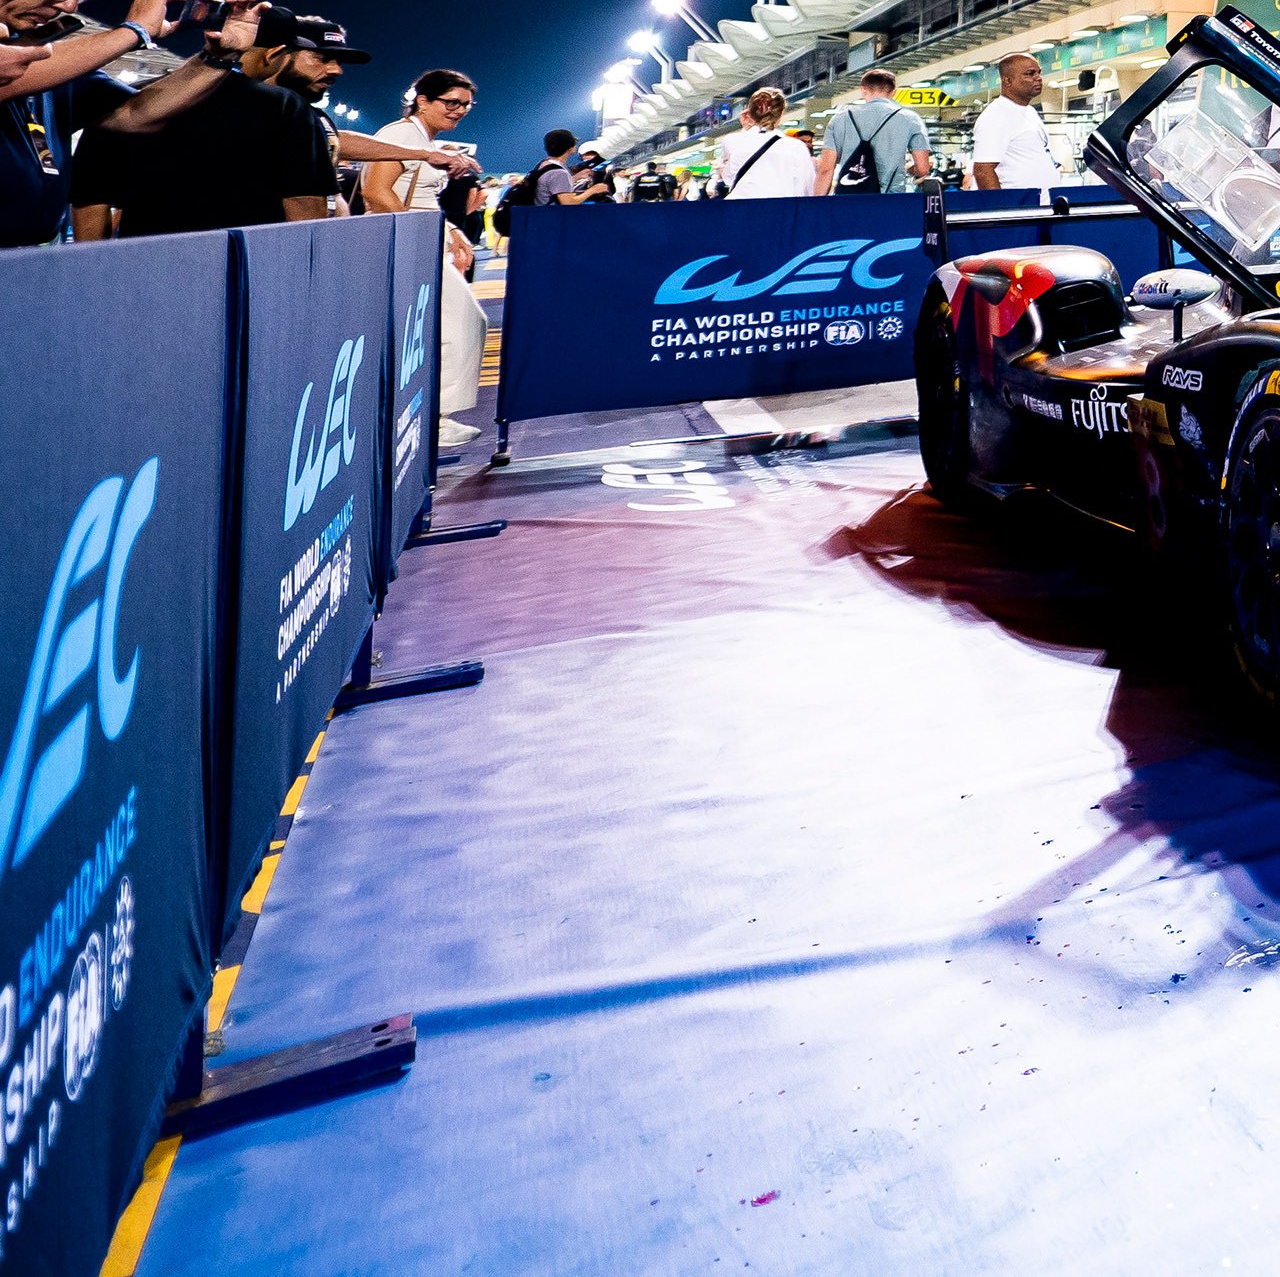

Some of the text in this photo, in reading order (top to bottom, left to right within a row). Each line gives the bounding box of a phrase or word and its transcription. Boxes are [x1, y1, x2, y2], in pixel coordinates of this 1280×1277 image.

[909, 90, 936, 106] 93
[924, 195, 940, 214] JFE
[653, 237, 924, 305] WEC
[1138, 282, 1158, 295] Mobil
[651, 299, 905, 333] FIA WORLD ENDURANCE
[399, 283, 430, 391] WEC
[650, 322, 821, 348] CHAMPIONSHIP
[650, 338, 820, 362] A PARTNERSHIP
[826, 325, 863, 343] FIA
[1162, 364, 1203, 392] RAYS
[1071, 384, 1129, 440] FUJITS
[284, 334, 365, 532] WEC
[279, 570, 294, 615] FIA
[294, 537, 320, 596] WORLD
[277, 561, 332, 661] CHAMPIONSHIP
[0, 456, 160, 869] EC
[275, 681, 282, 705] A
[18, 784, 138, 1031] ENDURANCE
